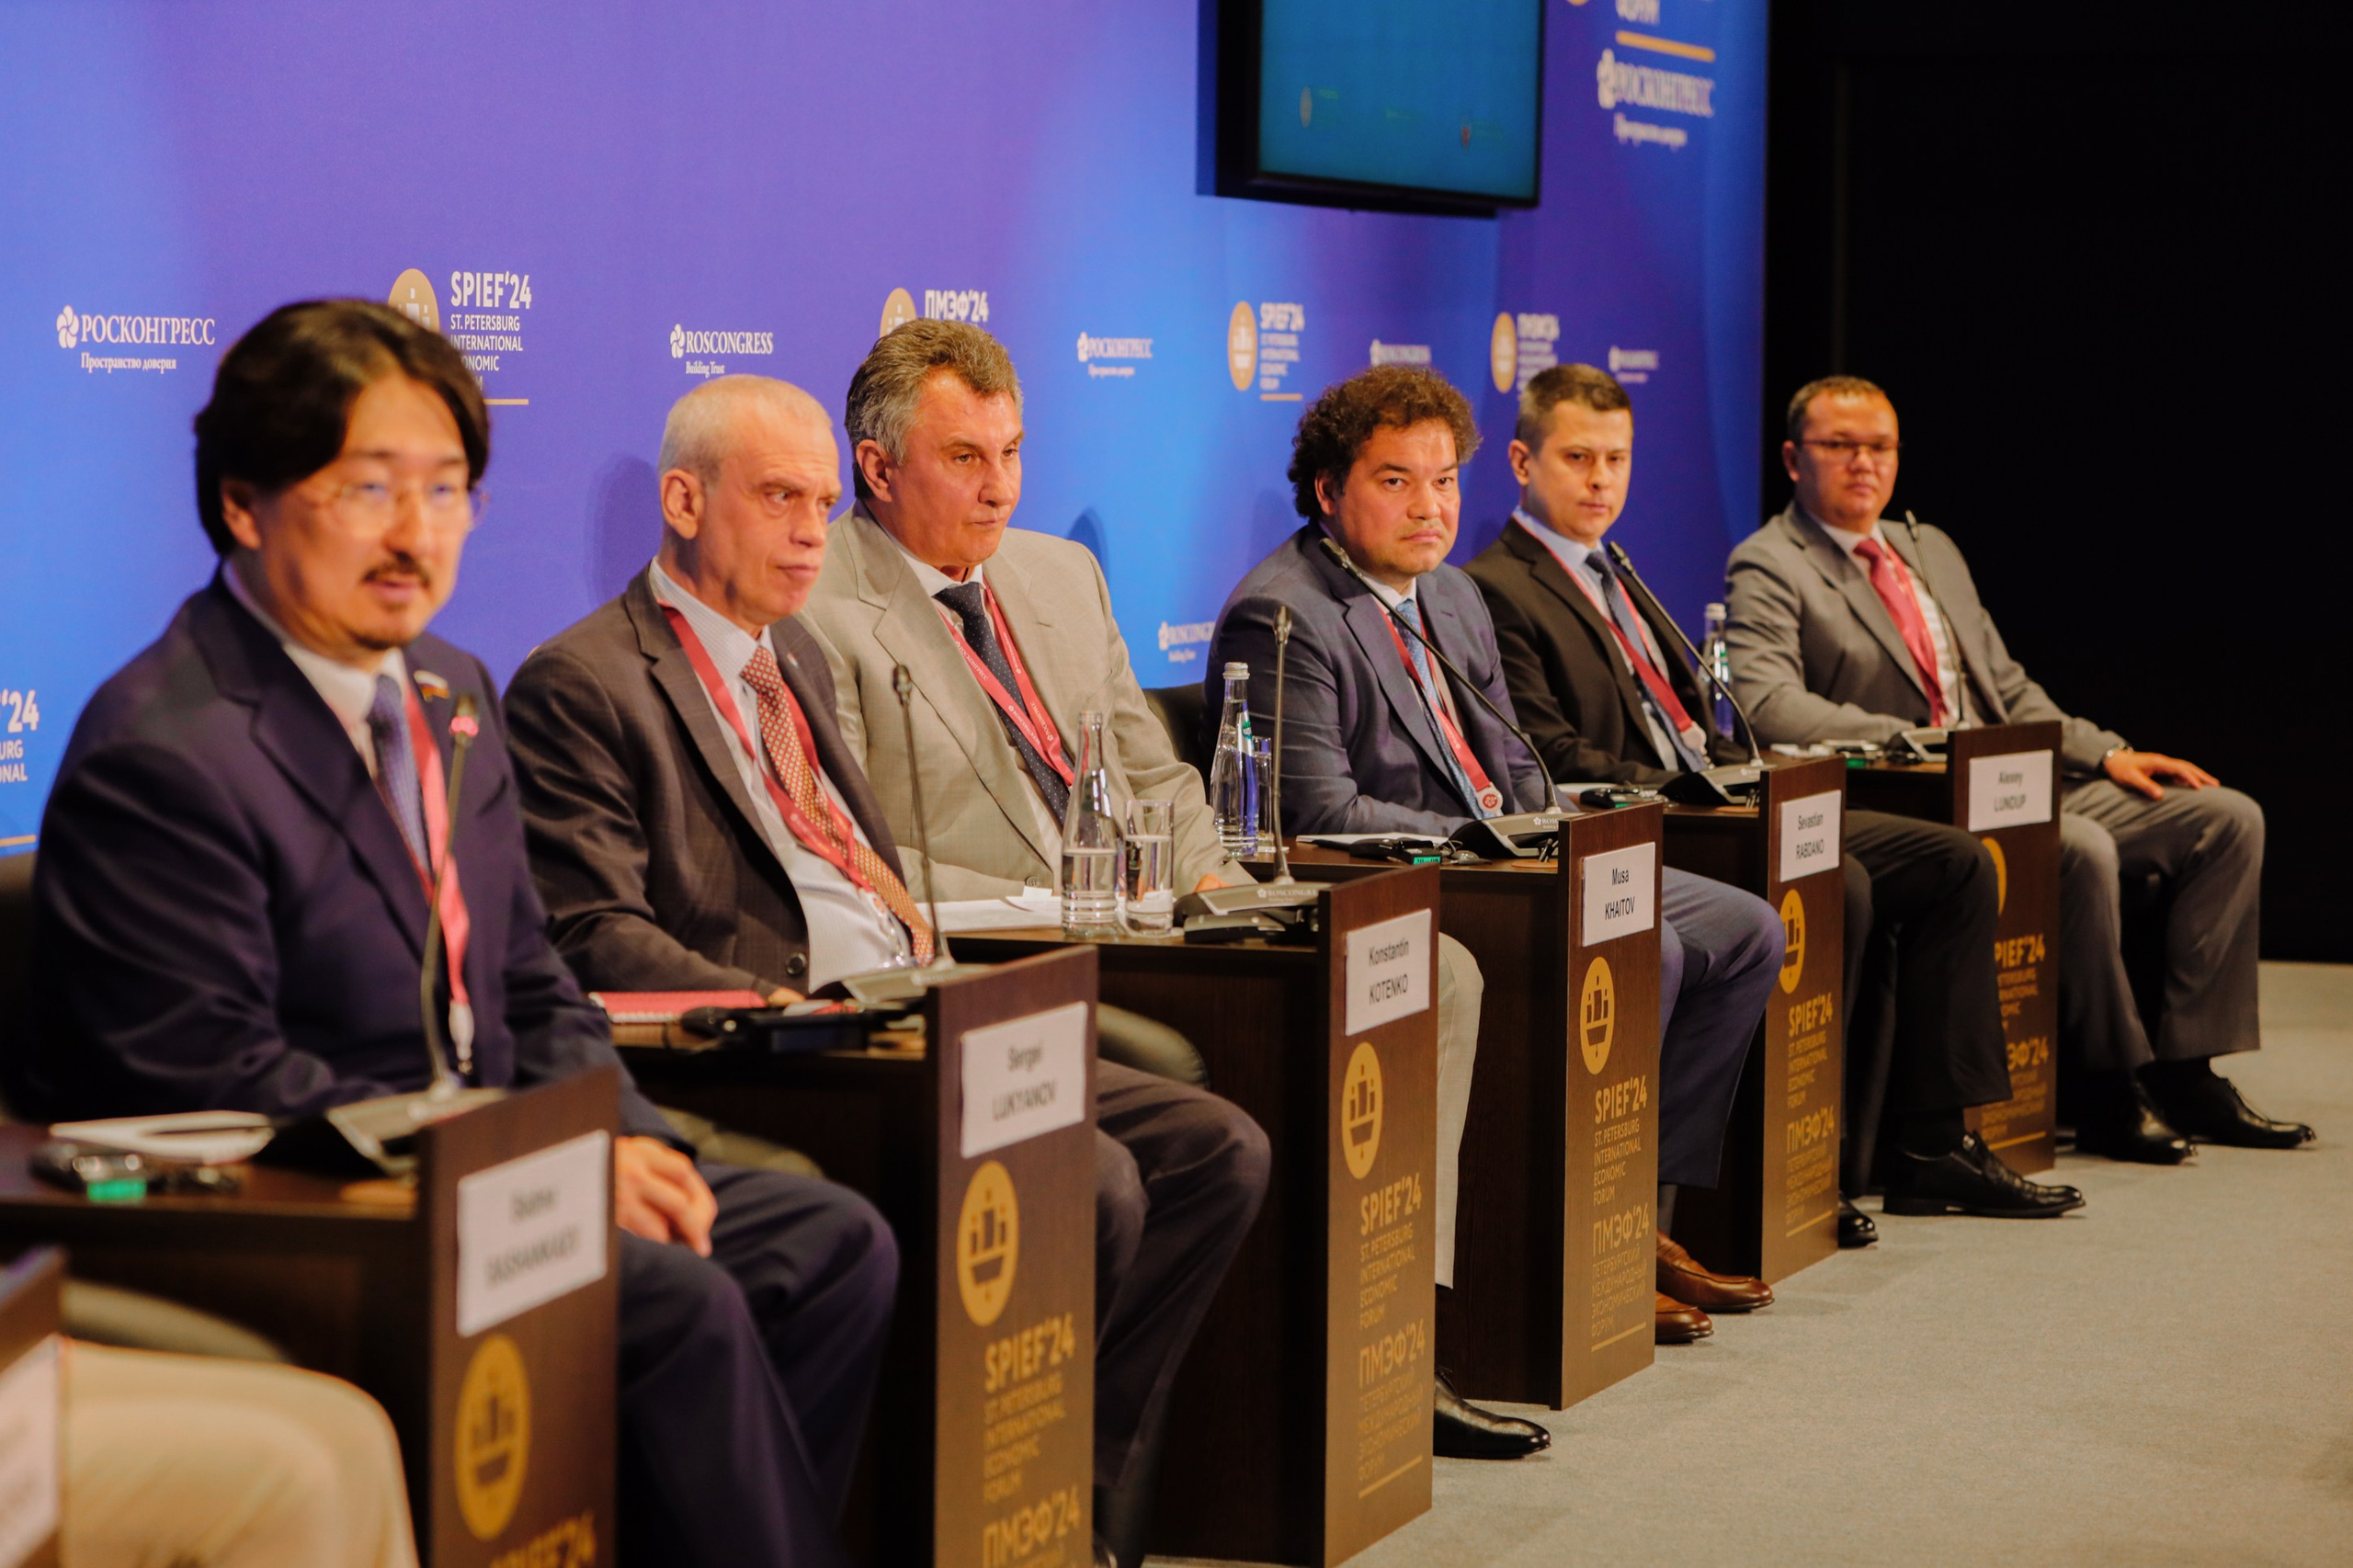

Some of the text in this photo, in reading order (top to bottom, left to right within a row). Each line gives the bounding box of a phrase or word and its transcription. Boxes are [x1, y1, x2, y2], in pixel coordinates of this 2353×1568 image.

[81, 314, 215, 346] РОСКОНГРЕСС
[450, 313, 520, 332] ST. PETERSBURG
[450, 335, 523, 352] INTERNATIONAL
[686, 331, 774, 355] ROSCONGRESS
[81, 352, 176, 374] Пространство доверия
[1611, 868, 1629, 885] Musa
[1605, 896, 1635, 920] KHAITOV
[1369, 937, 1410, 966] Konstantin
[1370, 973, 1408, 1005] KOTENKO
[1595, 1074, 1648, 1124] SPIEF'24
[1604, 1118, 1640, 1144] PETERSBURG
[1594, 1137, 1642, 1167] INTERNATIONAL
[1594, 1161, 1626, 1187] ECONOMIC
[1594, 1186, 1615, 1207] FORUM
[1593, 1202, 1650, 1256] ПМЭФ'24
